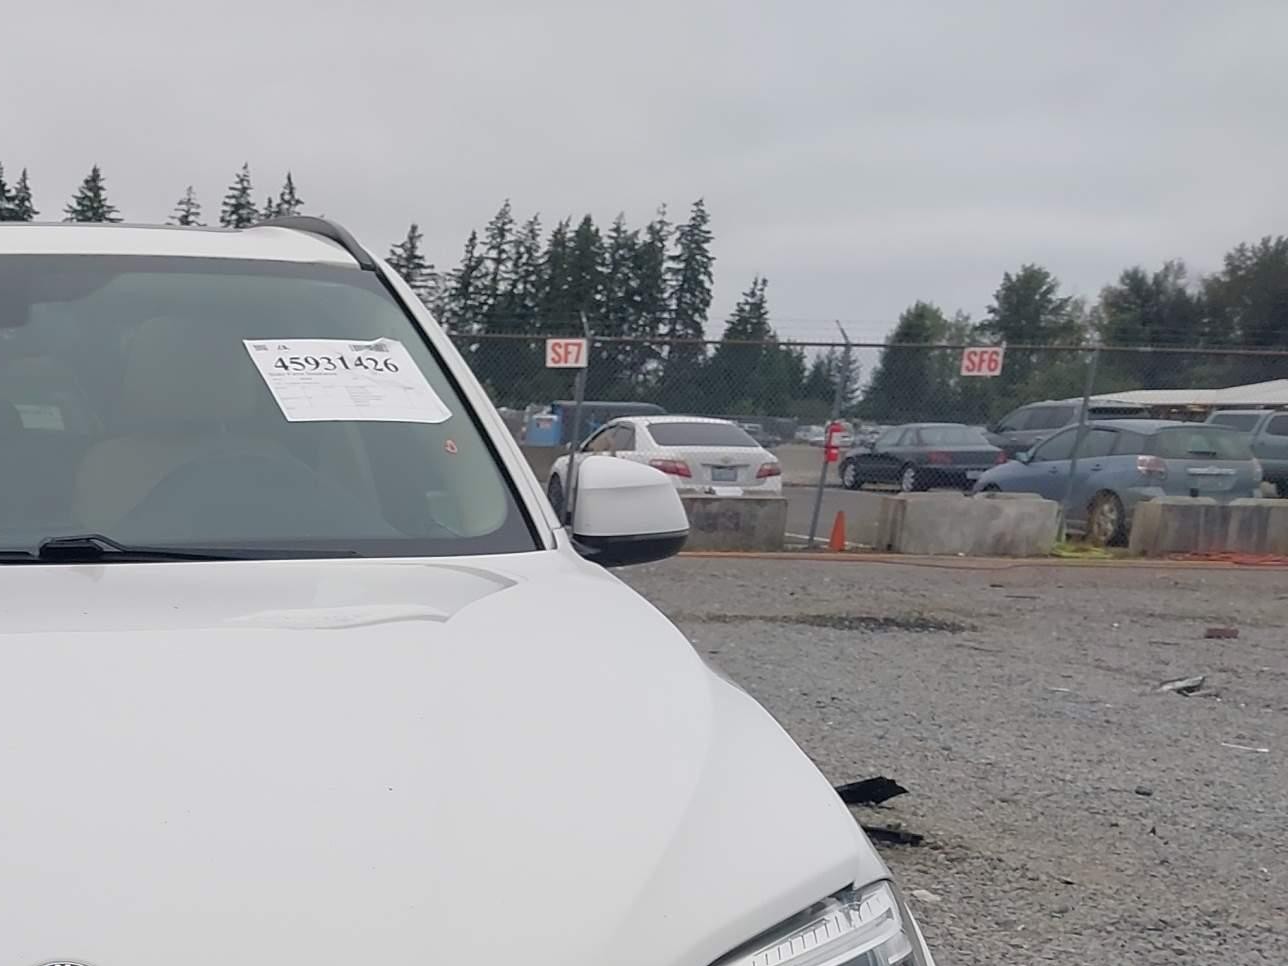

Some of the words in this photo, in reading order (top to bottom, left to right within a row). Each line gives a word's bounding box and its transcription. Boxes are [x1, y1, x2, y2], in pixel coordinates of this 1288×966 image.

[273, 355, 400, 373] 45931426
[551, 341, 583, 364] SF7
[964, 350, 1000, 373] SF6
